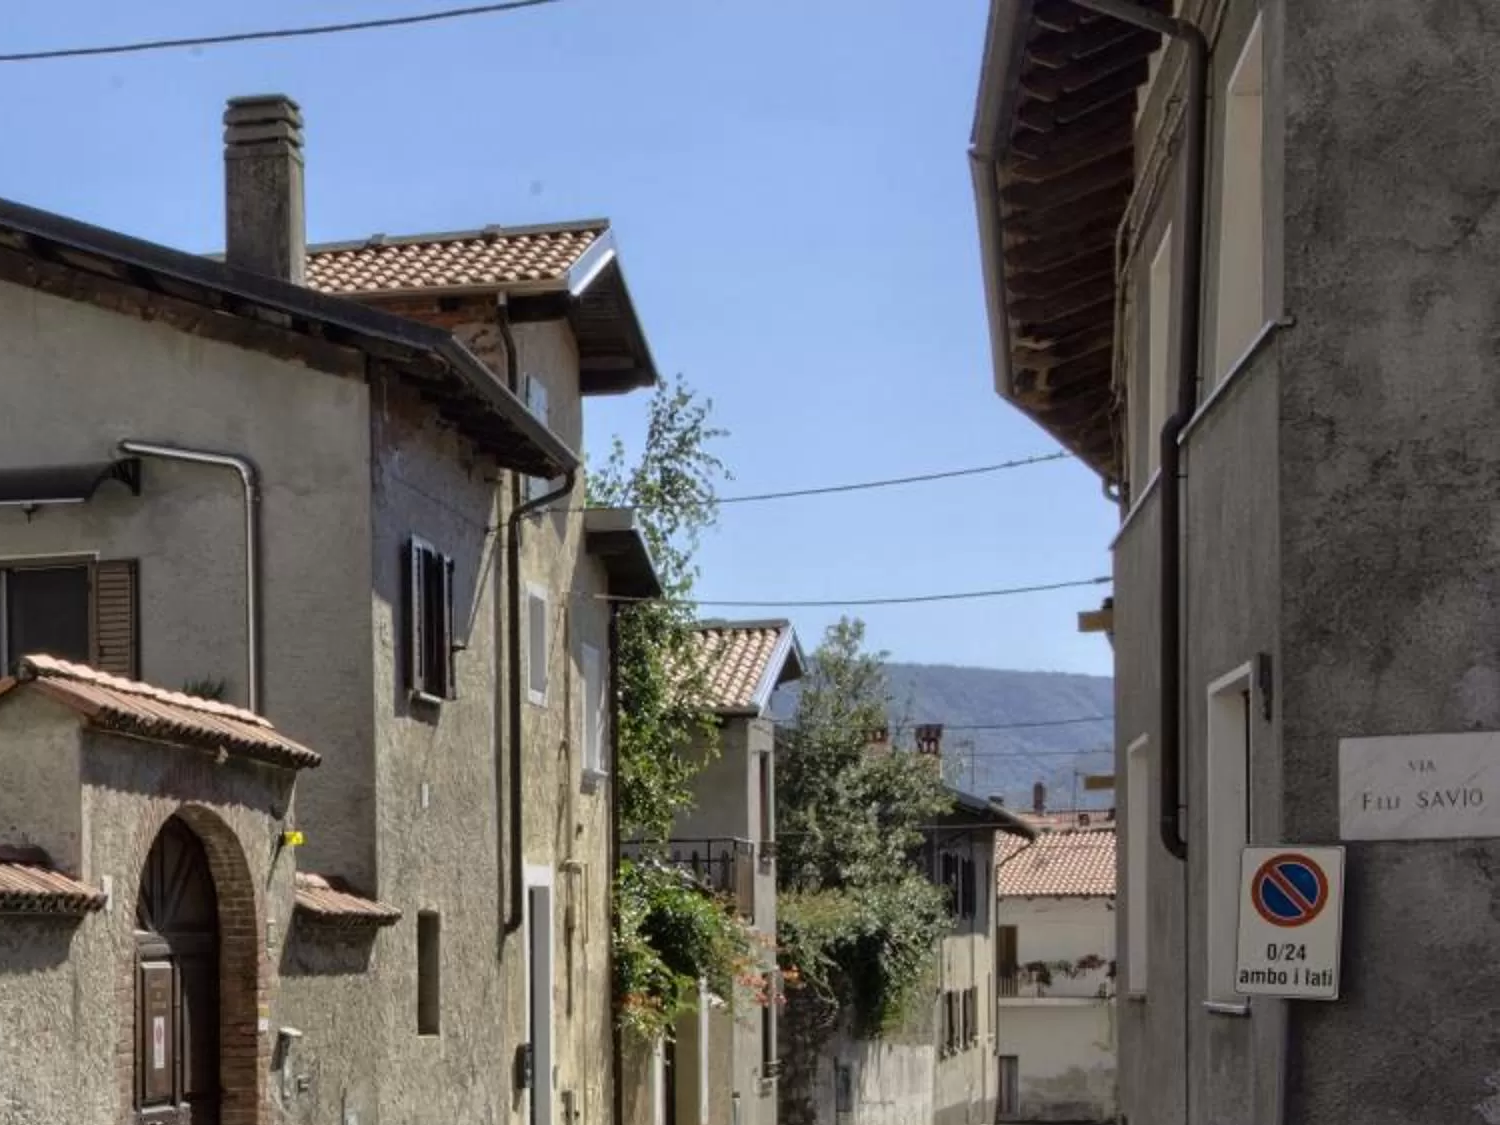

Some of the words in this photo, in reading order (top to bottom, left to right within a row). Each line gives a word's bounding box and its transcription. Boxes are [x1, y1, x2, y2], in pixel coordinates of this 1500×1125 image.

[1408, 759, 1437, 773] VIA
[1416, 787, 1485, 810] SAVIO
[1267, 943, 1307, 961] 0/24
[1239, 967, 1288, 985] ambo
[1305, 967, 1333, 987] lati
